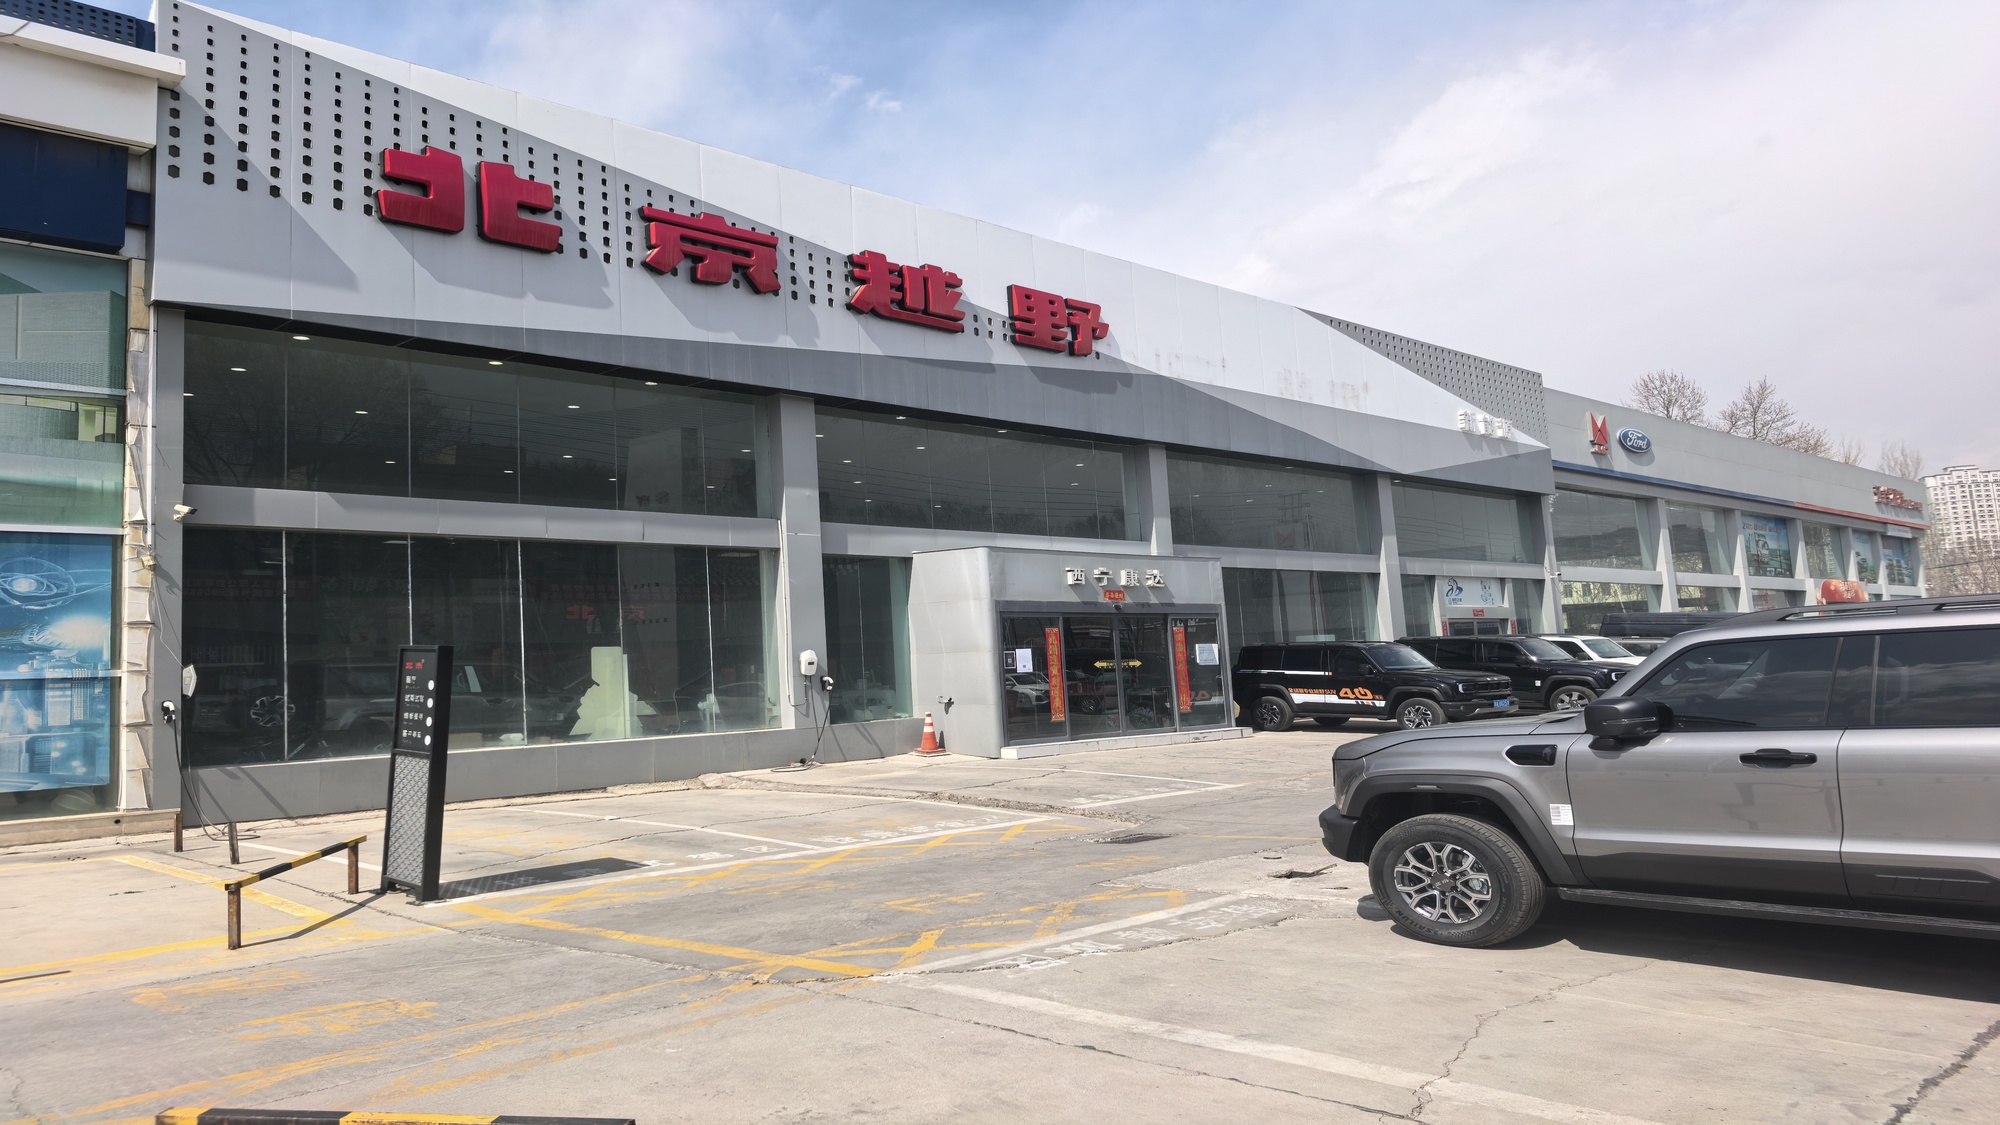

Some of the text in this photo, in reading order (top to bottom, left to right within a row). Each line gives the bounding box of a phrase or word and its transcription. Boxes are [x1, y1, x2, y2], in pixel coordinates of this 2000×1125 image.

[376, 144, 1110, 357] 北京越野
[1626, 430, 1648, 449] Ford
[1065, 567, 1165, 588] 西宁康达
